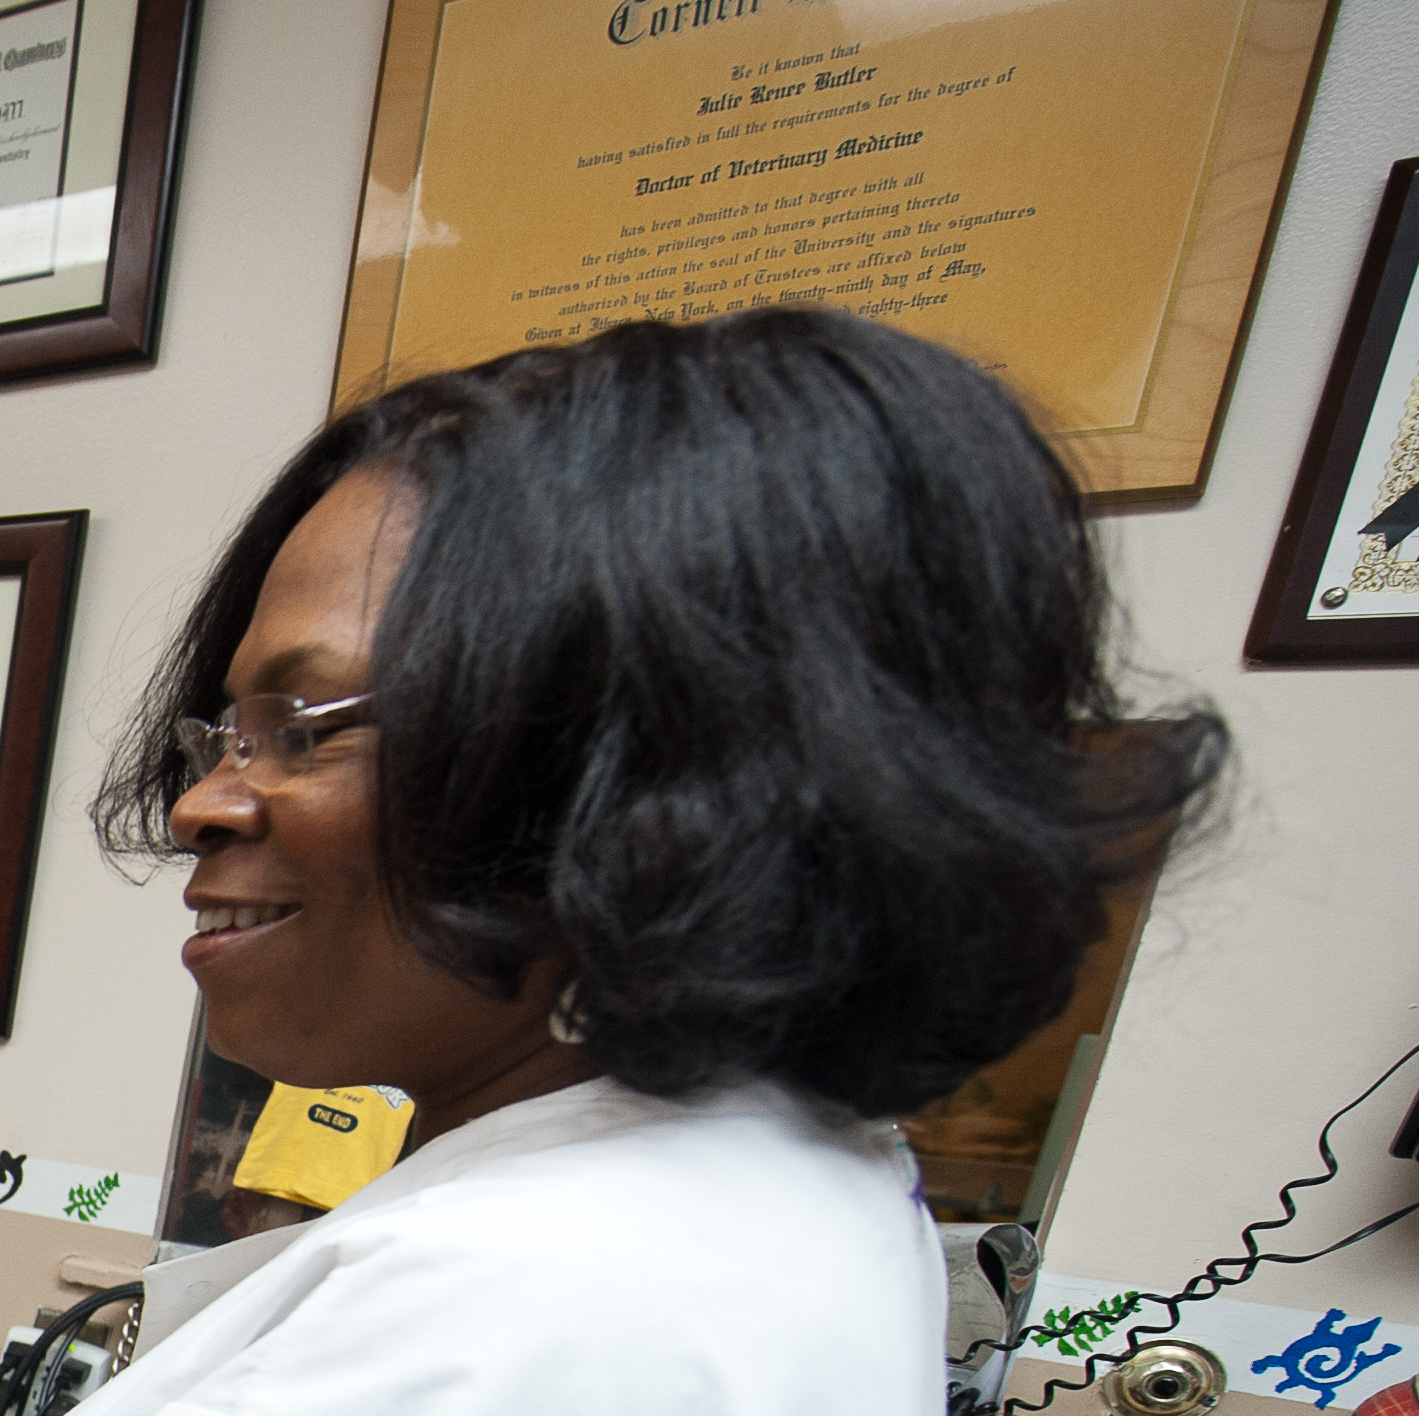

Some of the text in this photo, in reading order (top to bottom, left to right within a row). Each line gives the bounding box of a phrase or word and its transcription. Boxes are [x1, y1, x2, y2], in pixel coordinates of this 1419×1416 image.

[697, 65, 878, 116] Julie Renee Butler
[730, 41, 862, 81] Be it known that
[577, 66, 1016, 168] having satisfied in full the requirements for the degree of
[635, 130, 924, 197] Doctor of Veterinary Medicine
[581, 252, 602, 267] the
[657, 234, 726, 257] privileges
[731, 226, 758, 241] and
[764, 217, 816, 237] honors
[822, 202, 900, 229] pertaining
[905, 192, 961, 212] thereto
[620, 171, 925, 238] has been admitted to that degree with all
[511, 206, 1037, 302] in witness of this action the seal of the University and the signatures
[558, 240, 967, 317] authorized by the Board of Trustees are affixed below
[525, 325, 563, 343] Given
[568, 321, 581, 335] at
[681, 300, 719, 322] York,
[726, 298, 744, 312] on
[751, 291, 772, 307] the
[778, 275, 874, 303] twenty-ninth
[881, 271, 909, 290] day
[915, 265, 934, 283] of
[939, 258, 987, 283] May,
[858, 291, 949, 319] eighty-three
[314, 1106, 333, 1123] THE
